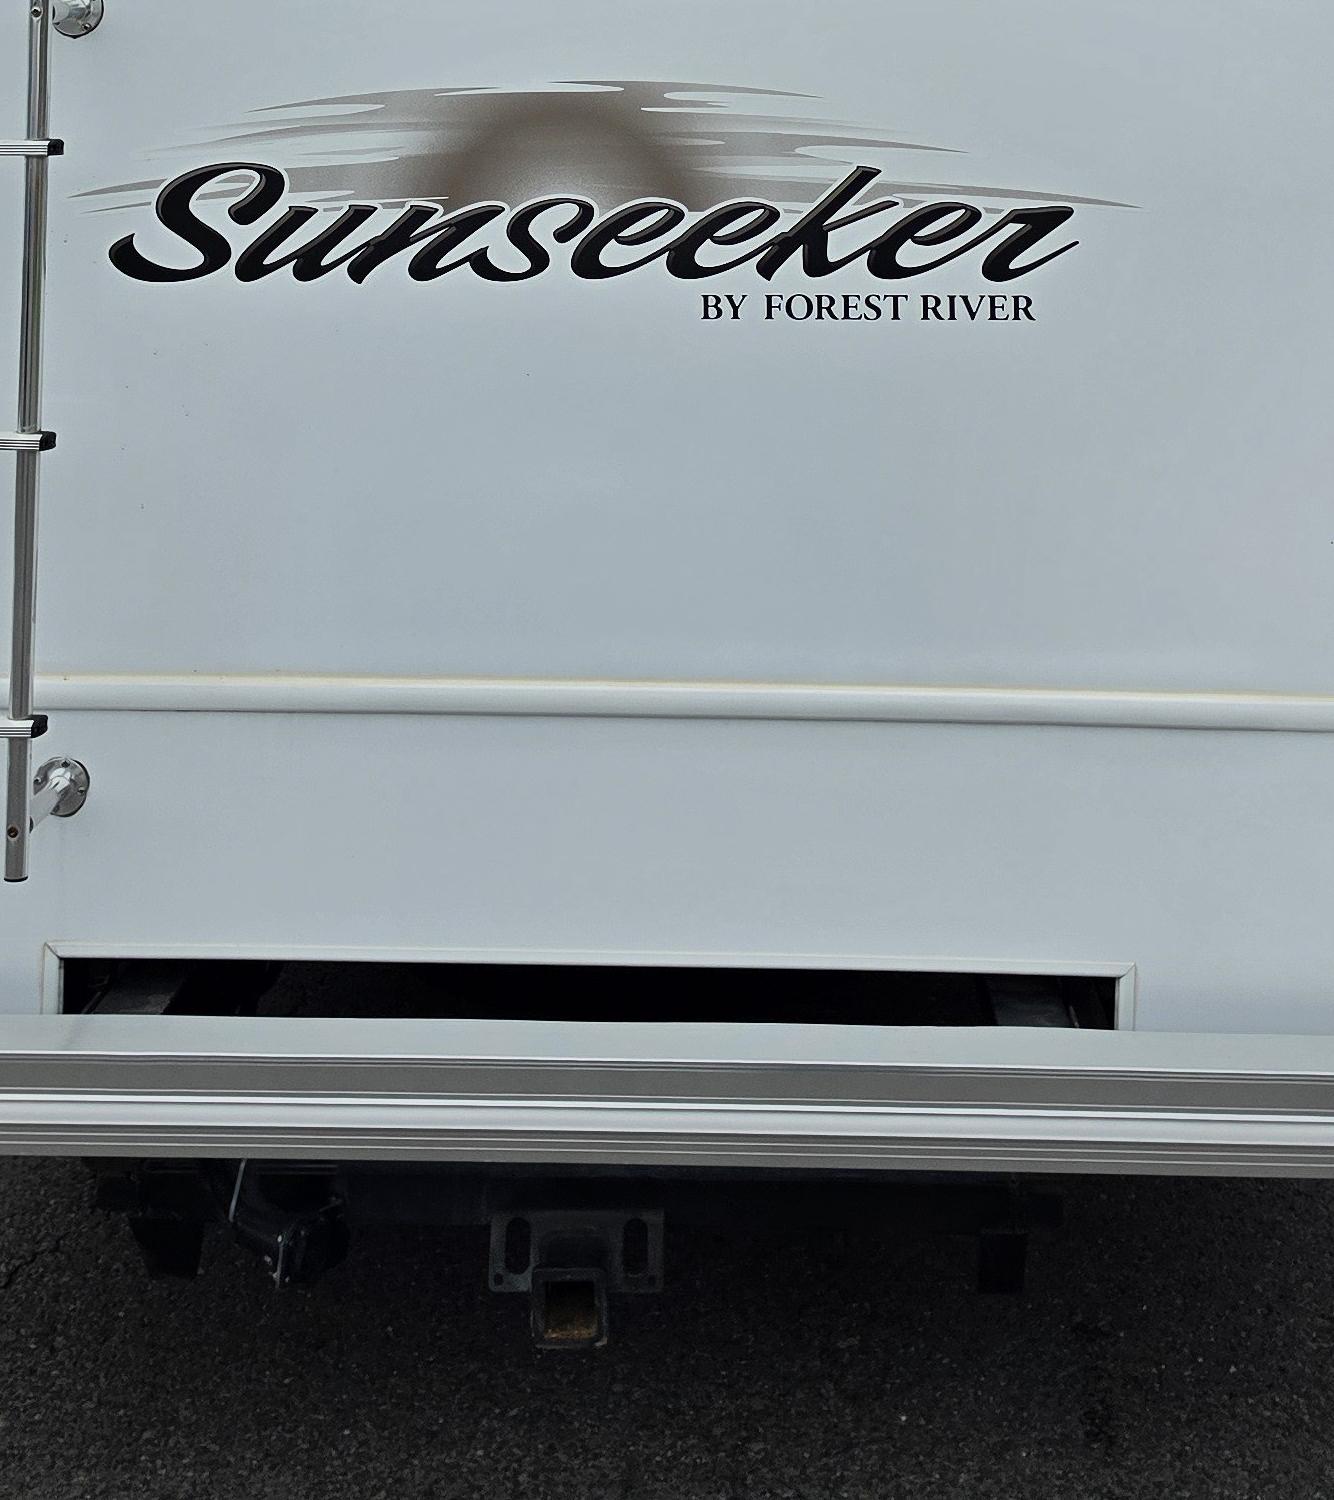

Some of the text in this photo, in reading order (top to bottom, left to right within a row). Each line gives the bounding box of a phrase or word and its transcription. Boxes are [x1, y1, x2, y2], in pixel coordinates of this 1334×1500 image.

[108, 162, 1080, 285] Sunseeker
[700, 293, 1037, 321] BY FOREST RIVER
